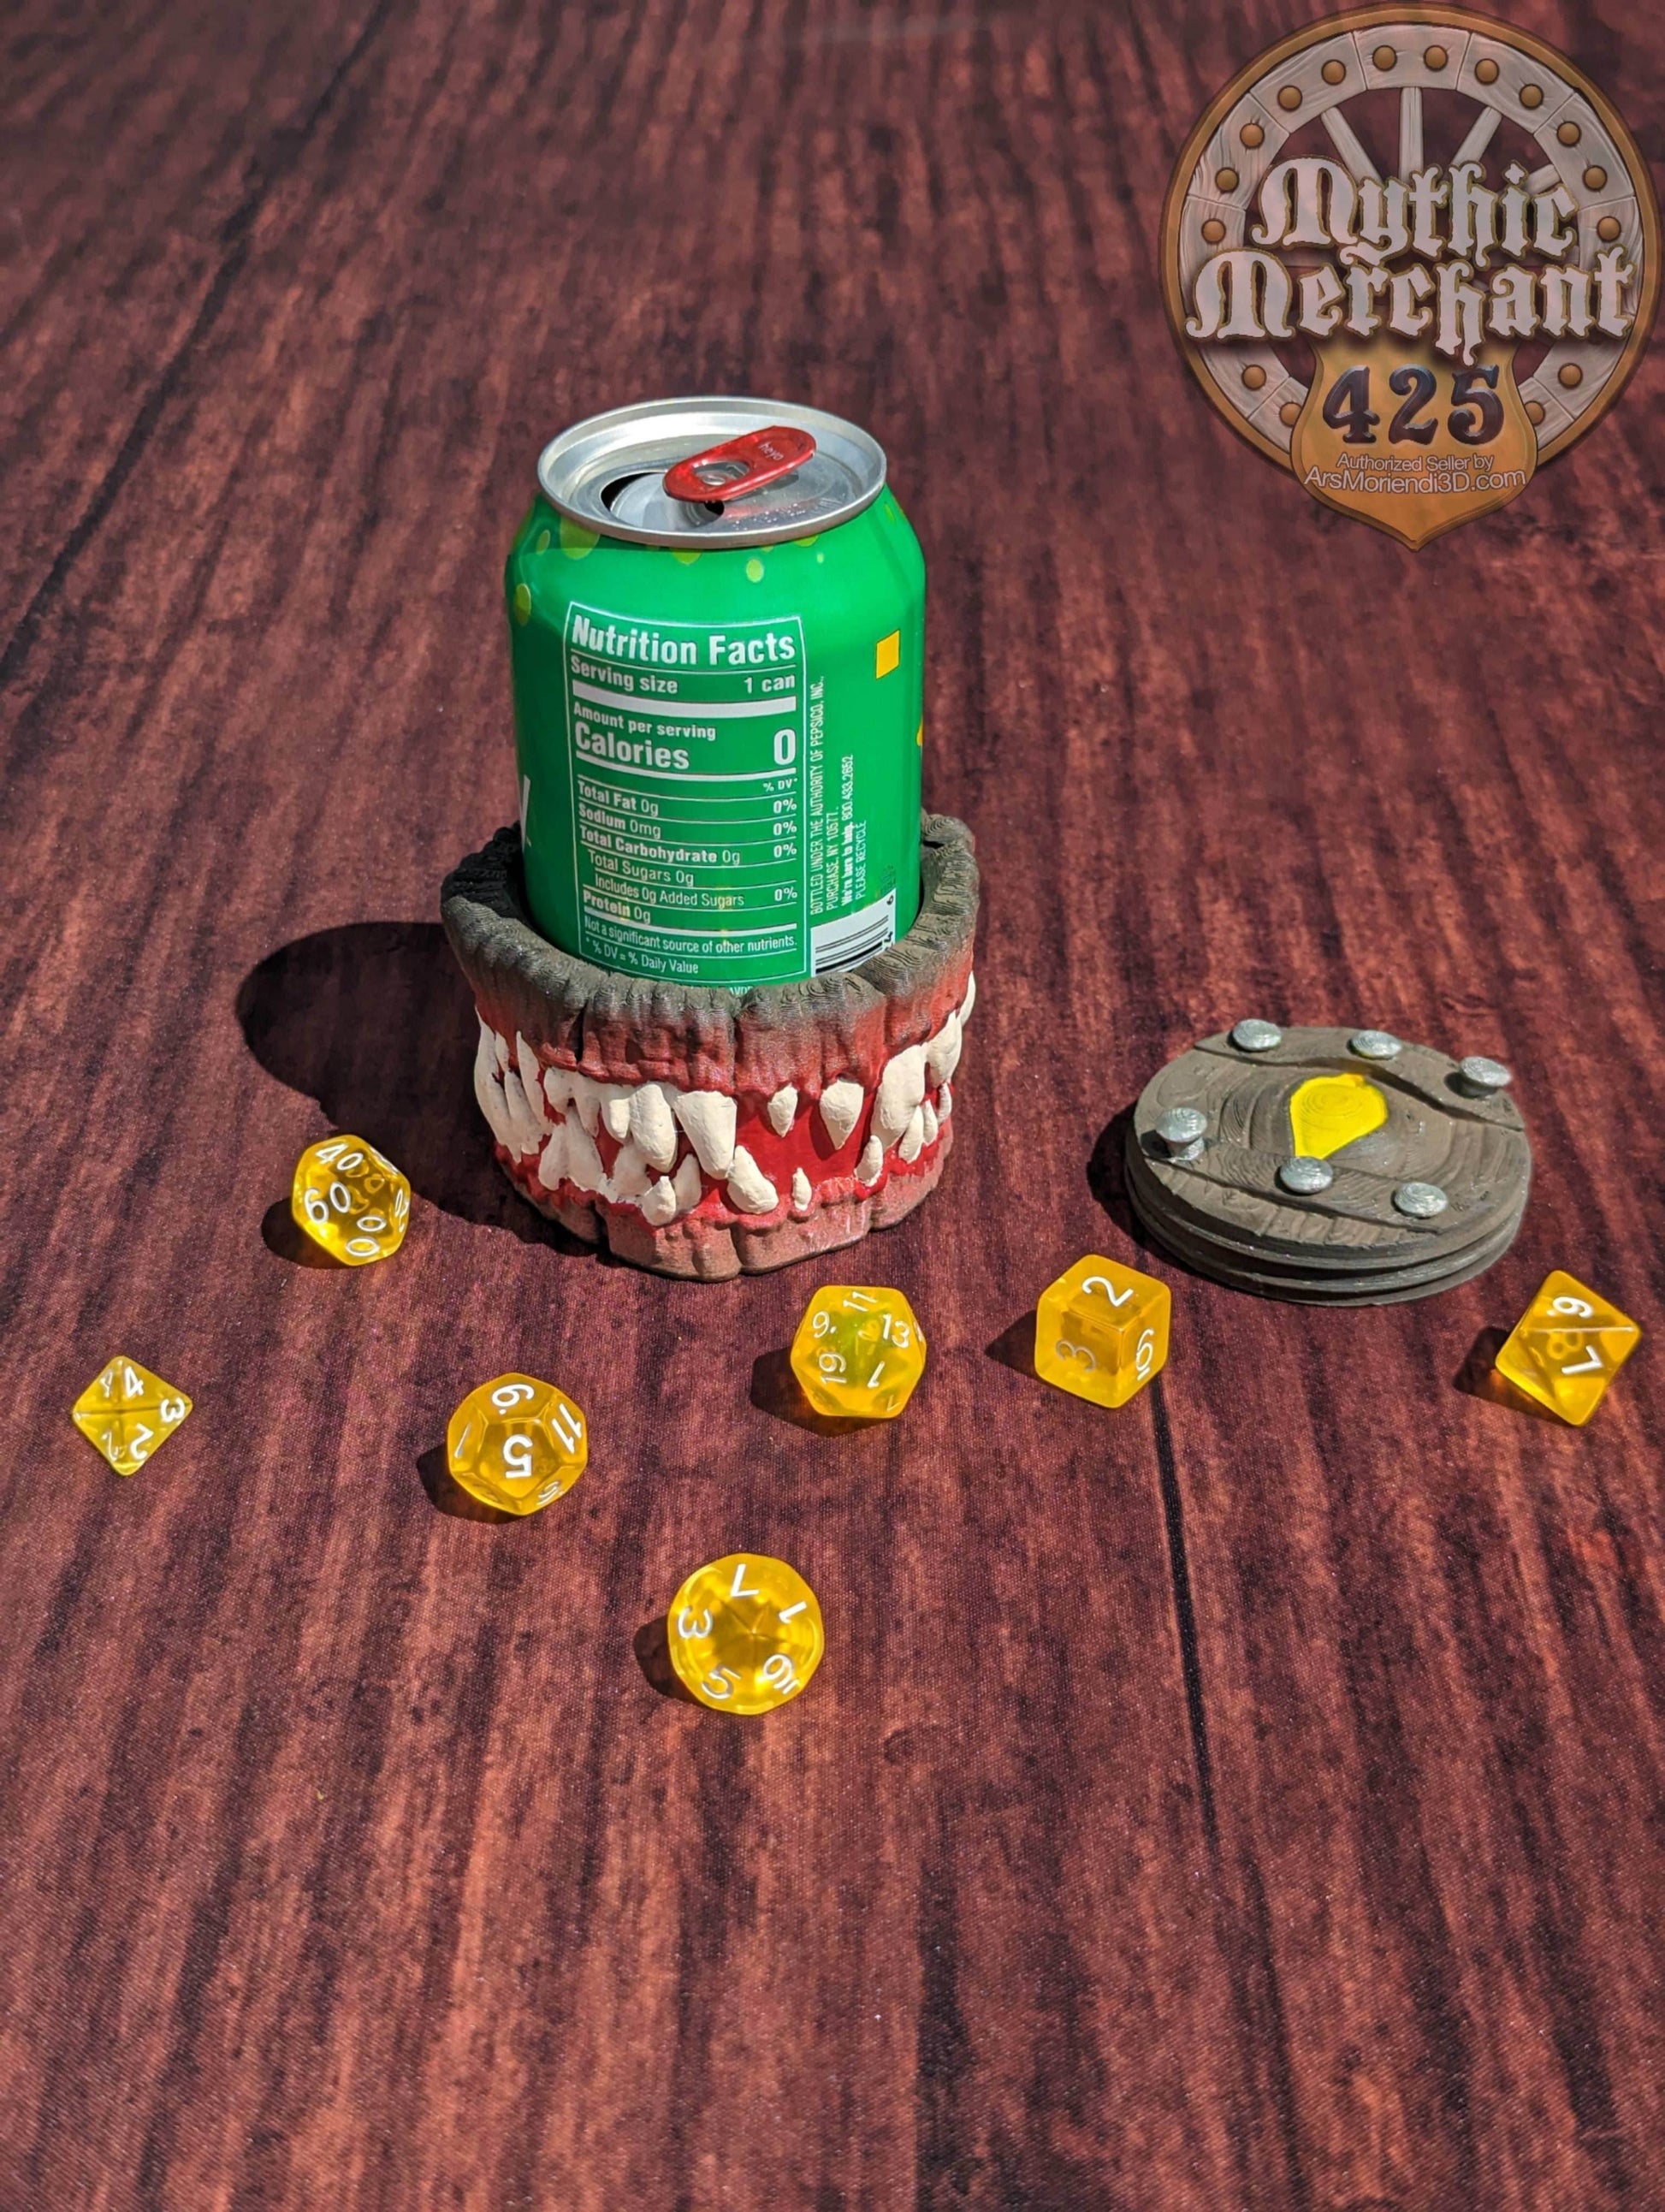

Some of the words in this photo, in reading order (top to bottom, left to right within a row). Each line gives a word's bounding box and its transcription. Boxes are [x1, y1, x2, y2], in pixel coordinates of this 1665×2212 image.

[572, 614, 697, 665] Nutrition
[709, 632, 796, 666] Facts
[571, 655, 634, 692] Serving
[640, 675, 678, 694] size
[744, 677, 752, 693] 1
[761, 674, 796, 692] can
[573, 702, 624, 728] Amount
[628, 721, 652, 733] per
[657, 723, 716, 741] serving
[575, 721, 690, 769] Calories
[773, 728, 796, 765] 0
[810, 750, 823, 762] OF
[578, 780, 609, 804] Total
[613, 792, 636, 811] Fat
[641, 799, 659, 816] 0g
[773, 799, 797, 813] 0%
[763, 782, 773, 792] %
[810, 765, 823, 815] AUTHORITY
[578, 804, 625, 830] Sodium
[630, 816, 661, 839] 0mg
[773, 821, 797, 836] 0%
[810, 817, 823, 839] THE
[580, 824, 612, 848] Total
[615, 835, 717, 863] Carbohydrate
[722, 850, 740, 865] 0g
[773, 844, 797, 858] 0%
[810, 839, 823, 872] UNDER
[826, 844, 838, 857] NY
[855, 820, 866, 863] RECYCLE
[588, 849, 618, 872] Total
[622, 859, 671, 882] Sugars
[676, 870, 694, 887] 0g
[855, 863, 866, 900] PLEASE
[584, 889, 630, 916] Protein
[634, 906, 651, 924] 0g
[595, 874, 639, 898] Includes
[643, 883, 656, 899] 0g
[660, 887, 697, 906] Added
[702, 893, 744, 910] Sugars
[774, 887, 797, 901] 0%
[810, 874, 823, 915] BOTTLED
[584, 916, 600, 933] Not
[601, 924, 607, 935] a
[608, 926, 661, 948] significant
[663, 940, 699, 952] source
[702, 939, 713, 952] of
[716, 939, 744, 953] other
[748, 934, 797, 952] nutrients.
[603, 944, 618, 959] DV
[628, 951, 638, 964] %
[641, 954, 667, 973] Daily
[668, 958, 698, 974] Value
[316, 1143, 364, 1171] 40
[304, 1181, 351, 1224] 60
[843, 1291, 878, 1312] 11
[1081, 1276, 1134, 1307] 2
[882, 1314, 910, 1349] 13
[124, 1366, 144, 1398] 4
[160, 1397, 186, 1422] 3
[130, 1422, 154, 1460] 2
[552, 1403, 582, 1454] 11
[503, 1434, 533, 1479] 5
[678, 1606, 713, 1639] 3
[701, 1664, 741, 1699] 5
